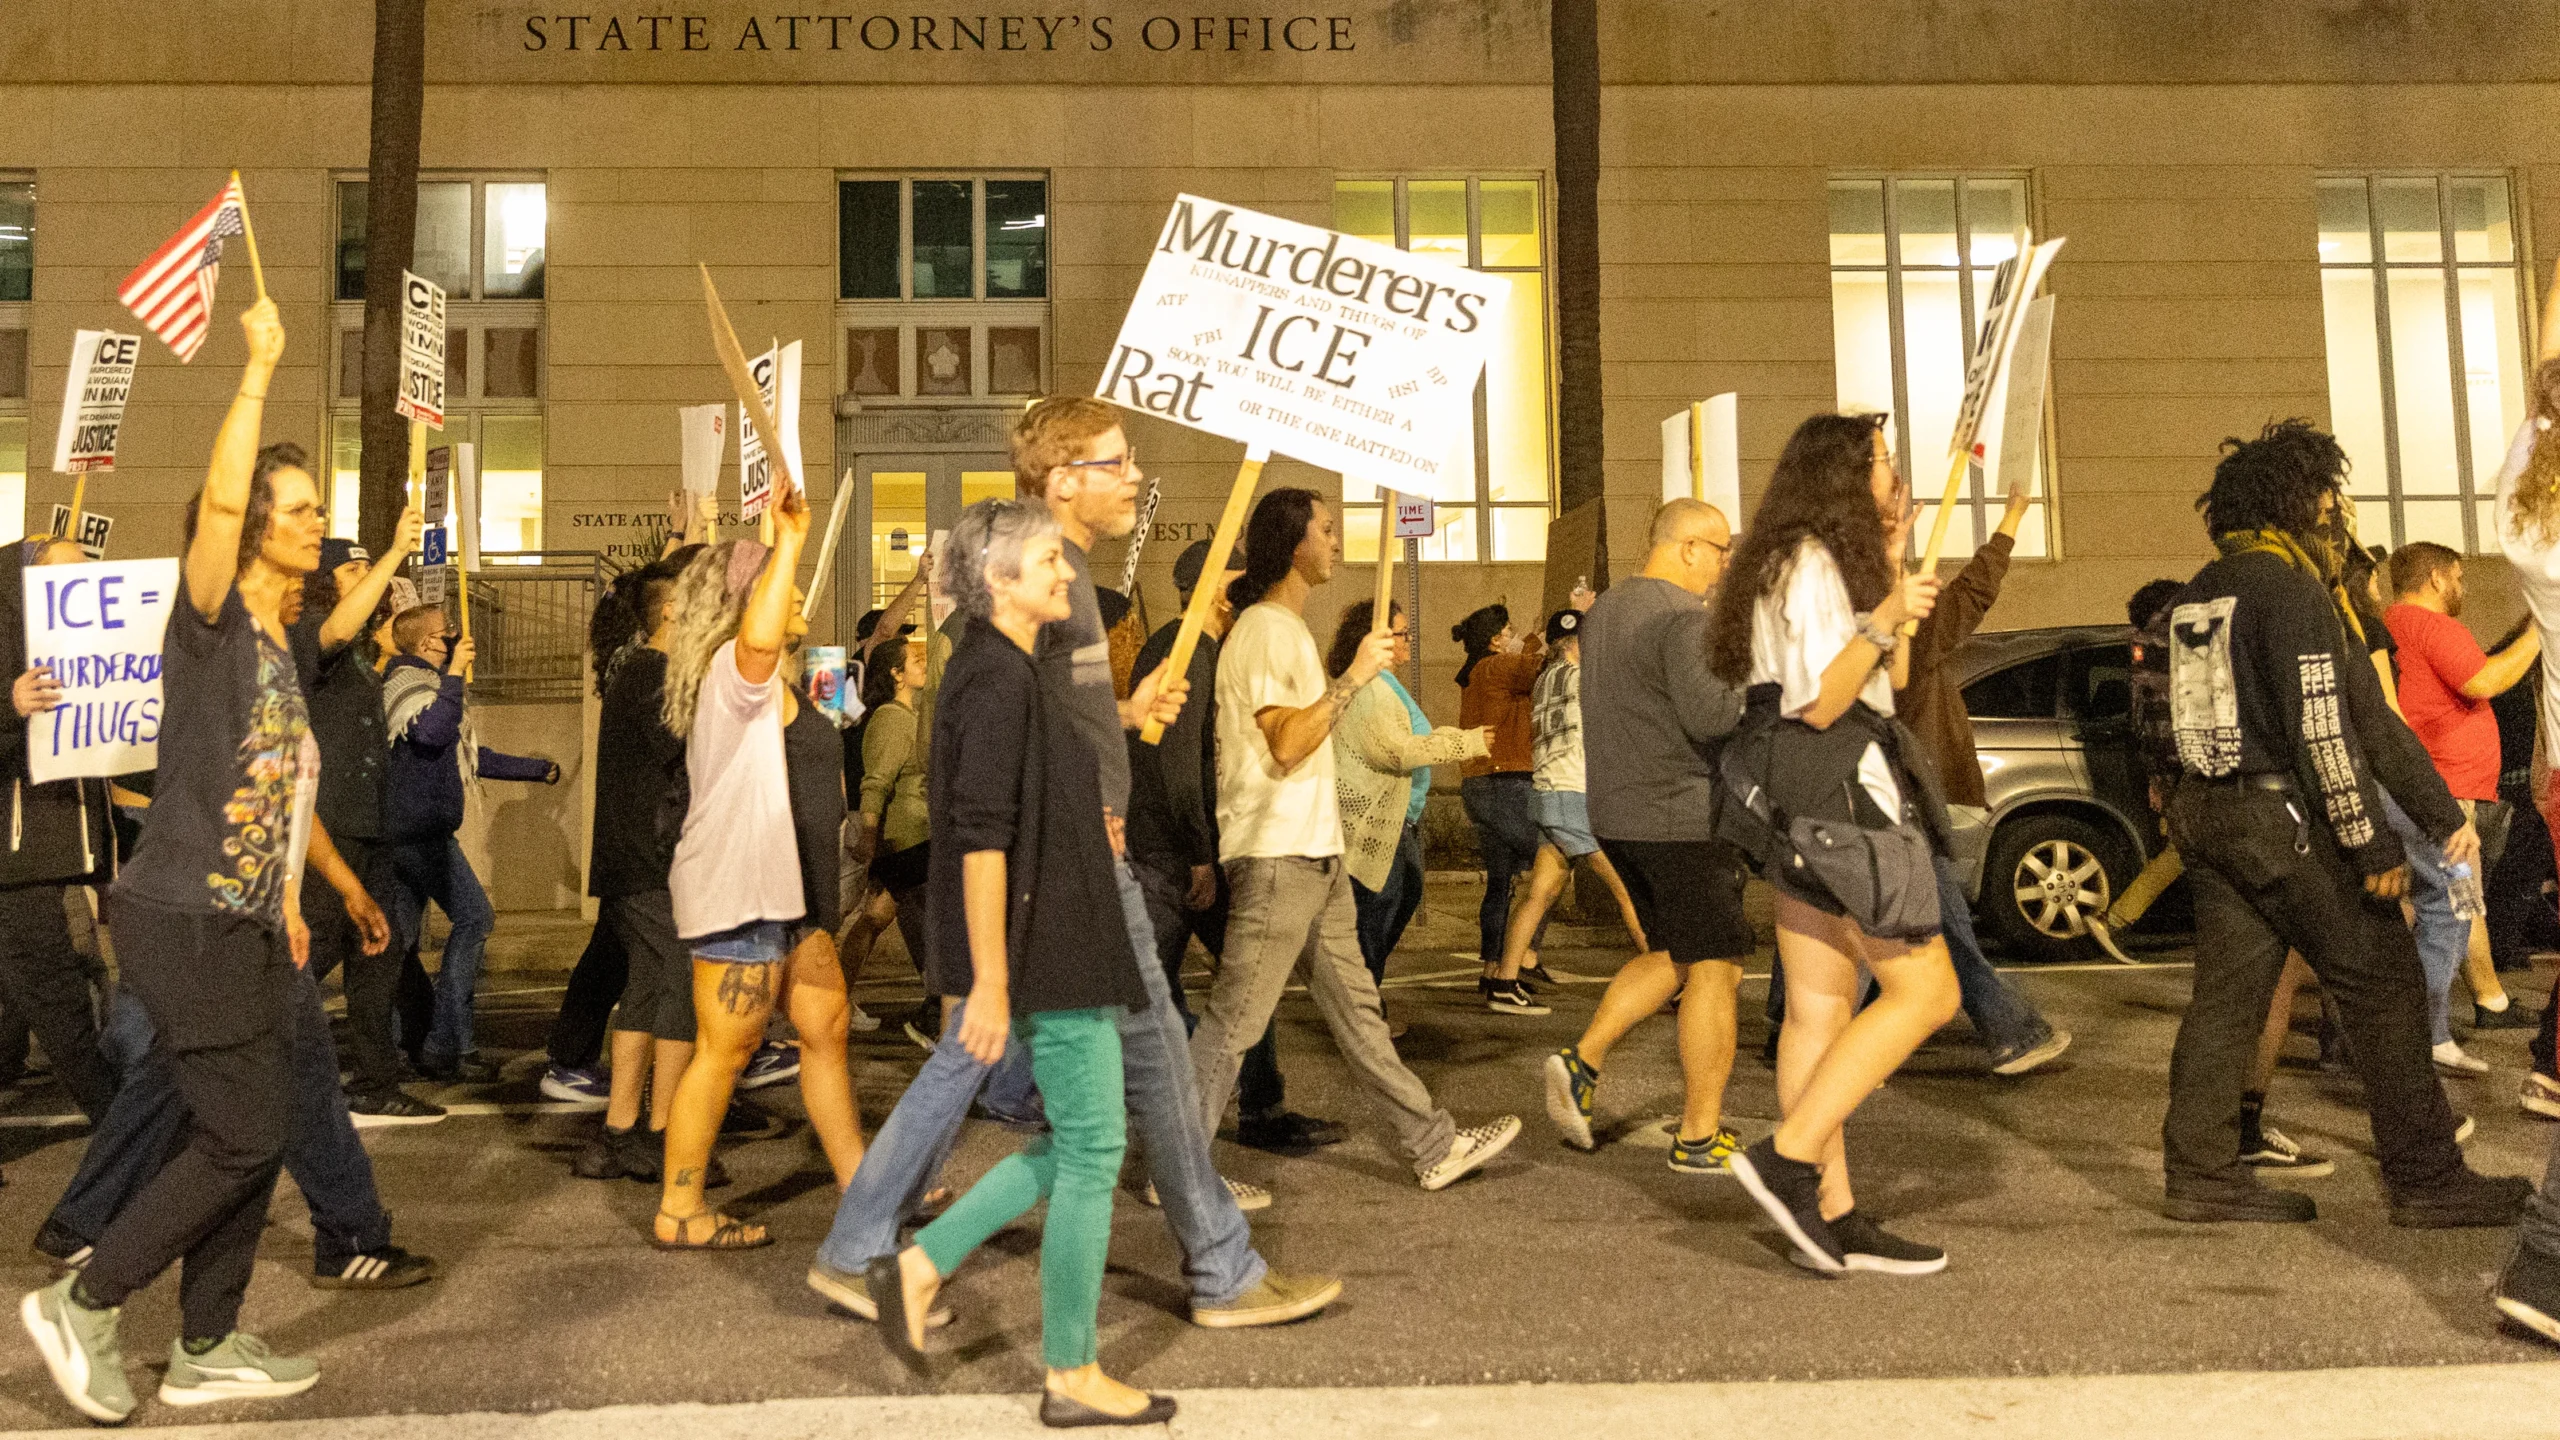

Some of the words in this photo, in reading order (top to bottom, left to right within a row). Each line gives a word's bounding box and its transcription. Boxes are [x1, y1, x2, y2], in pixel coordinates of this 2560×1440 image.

[523, 15, 710, 51] STATE
[733, 15, 1113, 51] ATTORNEY'S
[1141, 15, 1356, 51] OFFICE
[1158, 200, 1487, 333] Murderers
[1157, 293, 1188, 306] ATF
[1189, 264, 1290, 300] KIDNAPPERS
[1294, 294, 1332, 313] AND
[1339, 305, 1396, 332] THUGS
[1404, 325, 1427, 341] OF
[92, 338, 137, 364] ICE
[418, 333, 443, 357] MN
[1193, 328, 1223, 346] FBI
[1238, 305, 1372, 388] ICE
[90, 366, 132, 374] MURDERED
[93, 376, 130, 385] WOMAN
[1100, 343, 1214, 422] Rat
[1426, 365, 1448, 387] BP
[83, 387, 99, 401] IN
[100, 387, 127, 401] MN
[402, 365, 443, 410] JUSTICE
[1167, 346, 1210, 368] SOON
[1217, 359, 1249, 378] YOU
[1256, 370, 1295, 394] WILL
[1303, 385, 1326, 403] BE
[1332, 394, 1396, 426] EITHER
[1401, 418, 1413, 432] A
[1388, 379, 1421, 399] HSI
[90, 413, 121, 421] DEMAND
[72, 424, 118, 453] JUSTICE
[1239, 399, 1263, 416] OR
[1267, 407, 1302, 430] THE
[1305, 420, 1342, 442] ONE
[1344, 433, 1412, 464] RATTED
[1414, 456, 1439, 474] ON
[743, 457, 770, 496] JUST
[573, 514, 627, 527] STATE
[632, 513, 738, 527] ATTY'S
[1397, 505, 1424, 515] TIME
[53, 507, 110, 549] KIER
[1150, 522, 1198, 542] EST
[45, 575, 125, 630] ICE
[34, 651, 162, 688] MURDEROU
[2299, 663, 2312, 695] WILL
[2311, 662, 2324, 695] WILL
[2322, 661, 2336, 693] WILL
[52, 698, 160, 756] THUGS
[2302, 698, 2316, 740] NEVER
[2313, 696, 2329, 738] NEVER
[2326, 695, 2342, 736] NEVER
[2319, 740, 2344, 790] FORGET
[2332, 737, 2356, 786] FORGET
[2335, 794, 2351, 819] ALL
[2348, 791, 2364, 816] ALL
